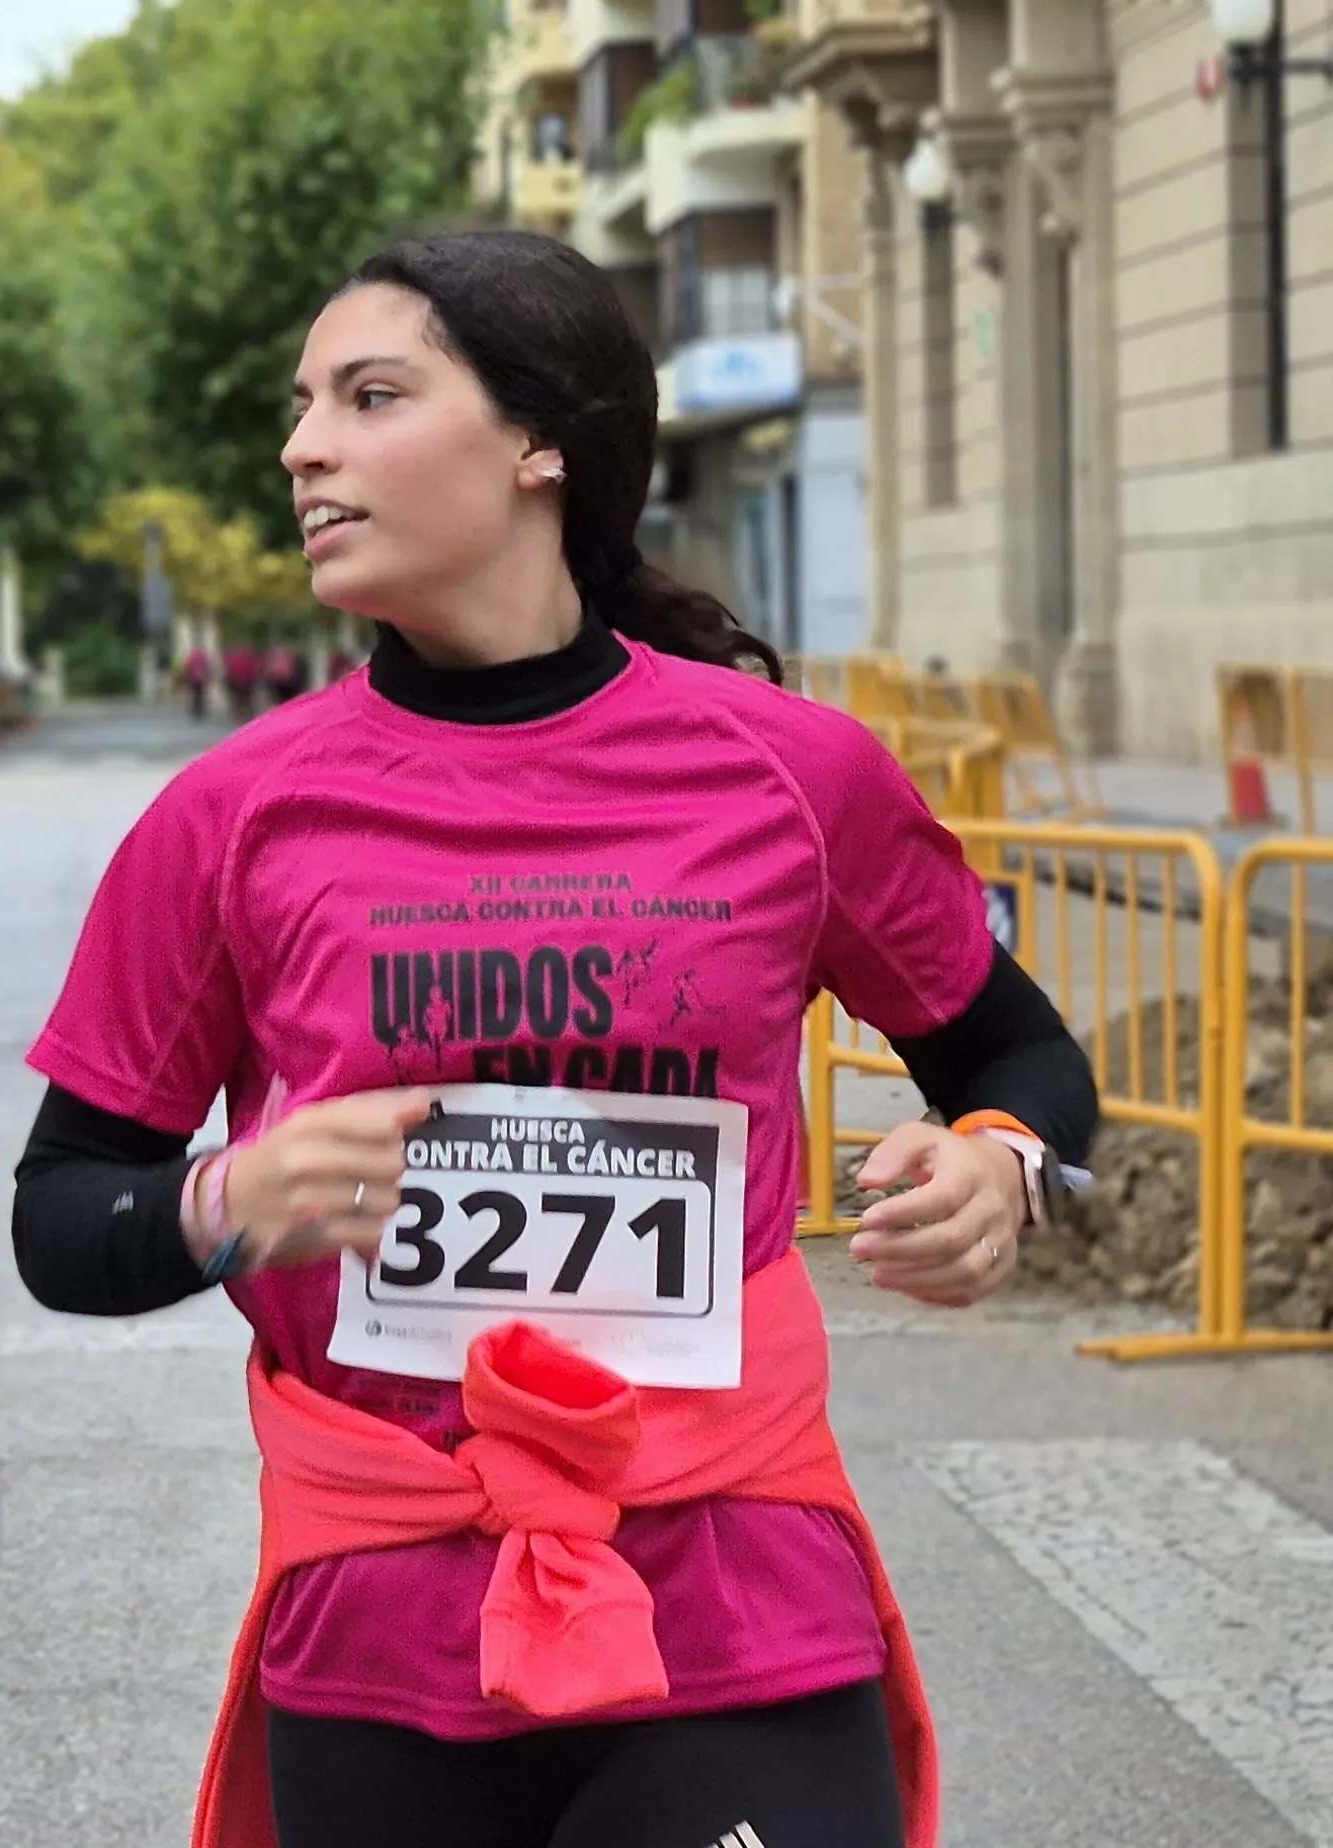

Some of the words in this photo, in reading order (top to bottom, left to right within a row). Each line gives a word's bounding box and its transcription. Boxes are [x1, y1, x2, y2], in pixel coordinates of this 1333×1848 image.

[470, 875, 502, 893] XII
[511, 872, 632, 893] CARRERA
[370, 902, 470, 926] HUESCA
[478, 899, 583, 921] CONTRA
[592, 898, 619, 919] EL
[371, 946, 614, 1047] UNIDOS
[490, 1117, 586, 1145] HUESCA
[404, 1139, 513, 1172] ONTRA
[522, 1143, 558, 1173] EL
[566, 1139, 697, 1180] CÁNCER
[379, 1186, 687, 1299] 3271
